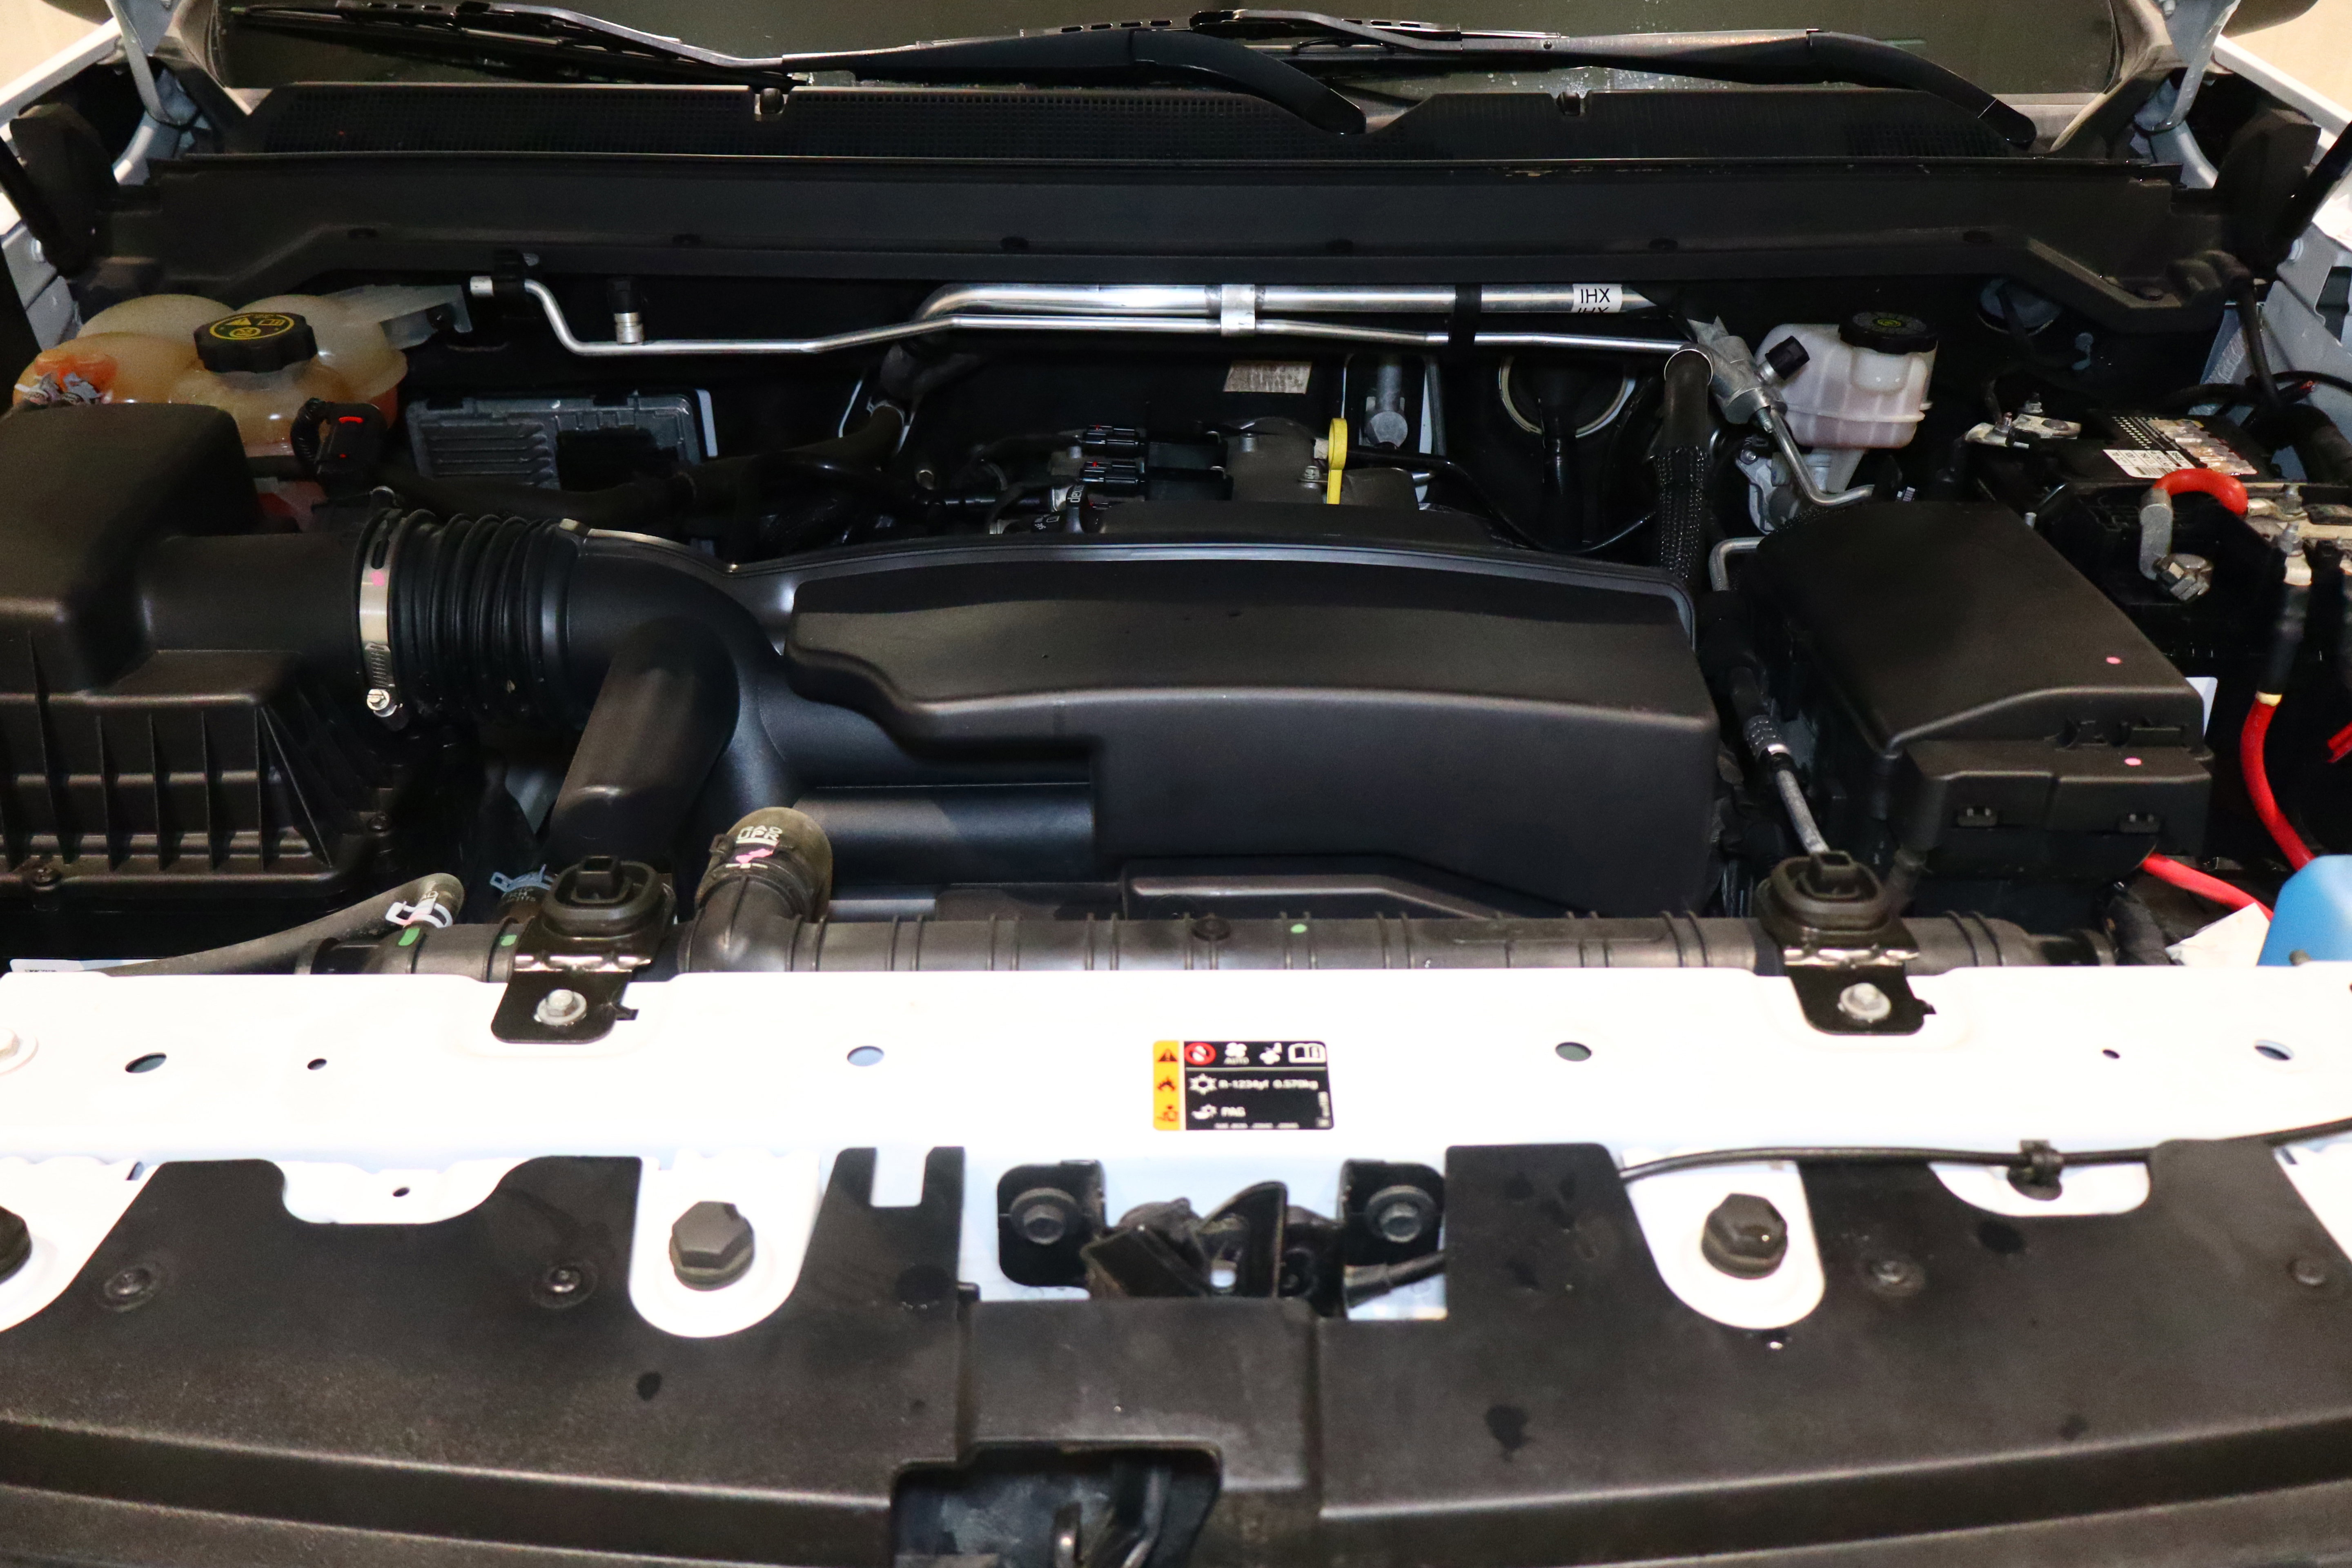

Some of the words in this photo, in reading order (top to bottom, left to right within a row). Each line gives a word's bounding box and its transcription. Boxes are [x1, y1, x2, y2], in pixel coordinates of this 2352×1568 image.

[1580, 288, 1610, 303] IHX
[1223, 1056, 1250, 1065] AUTO
[1220, 1106, 1246, 1117] PAG
